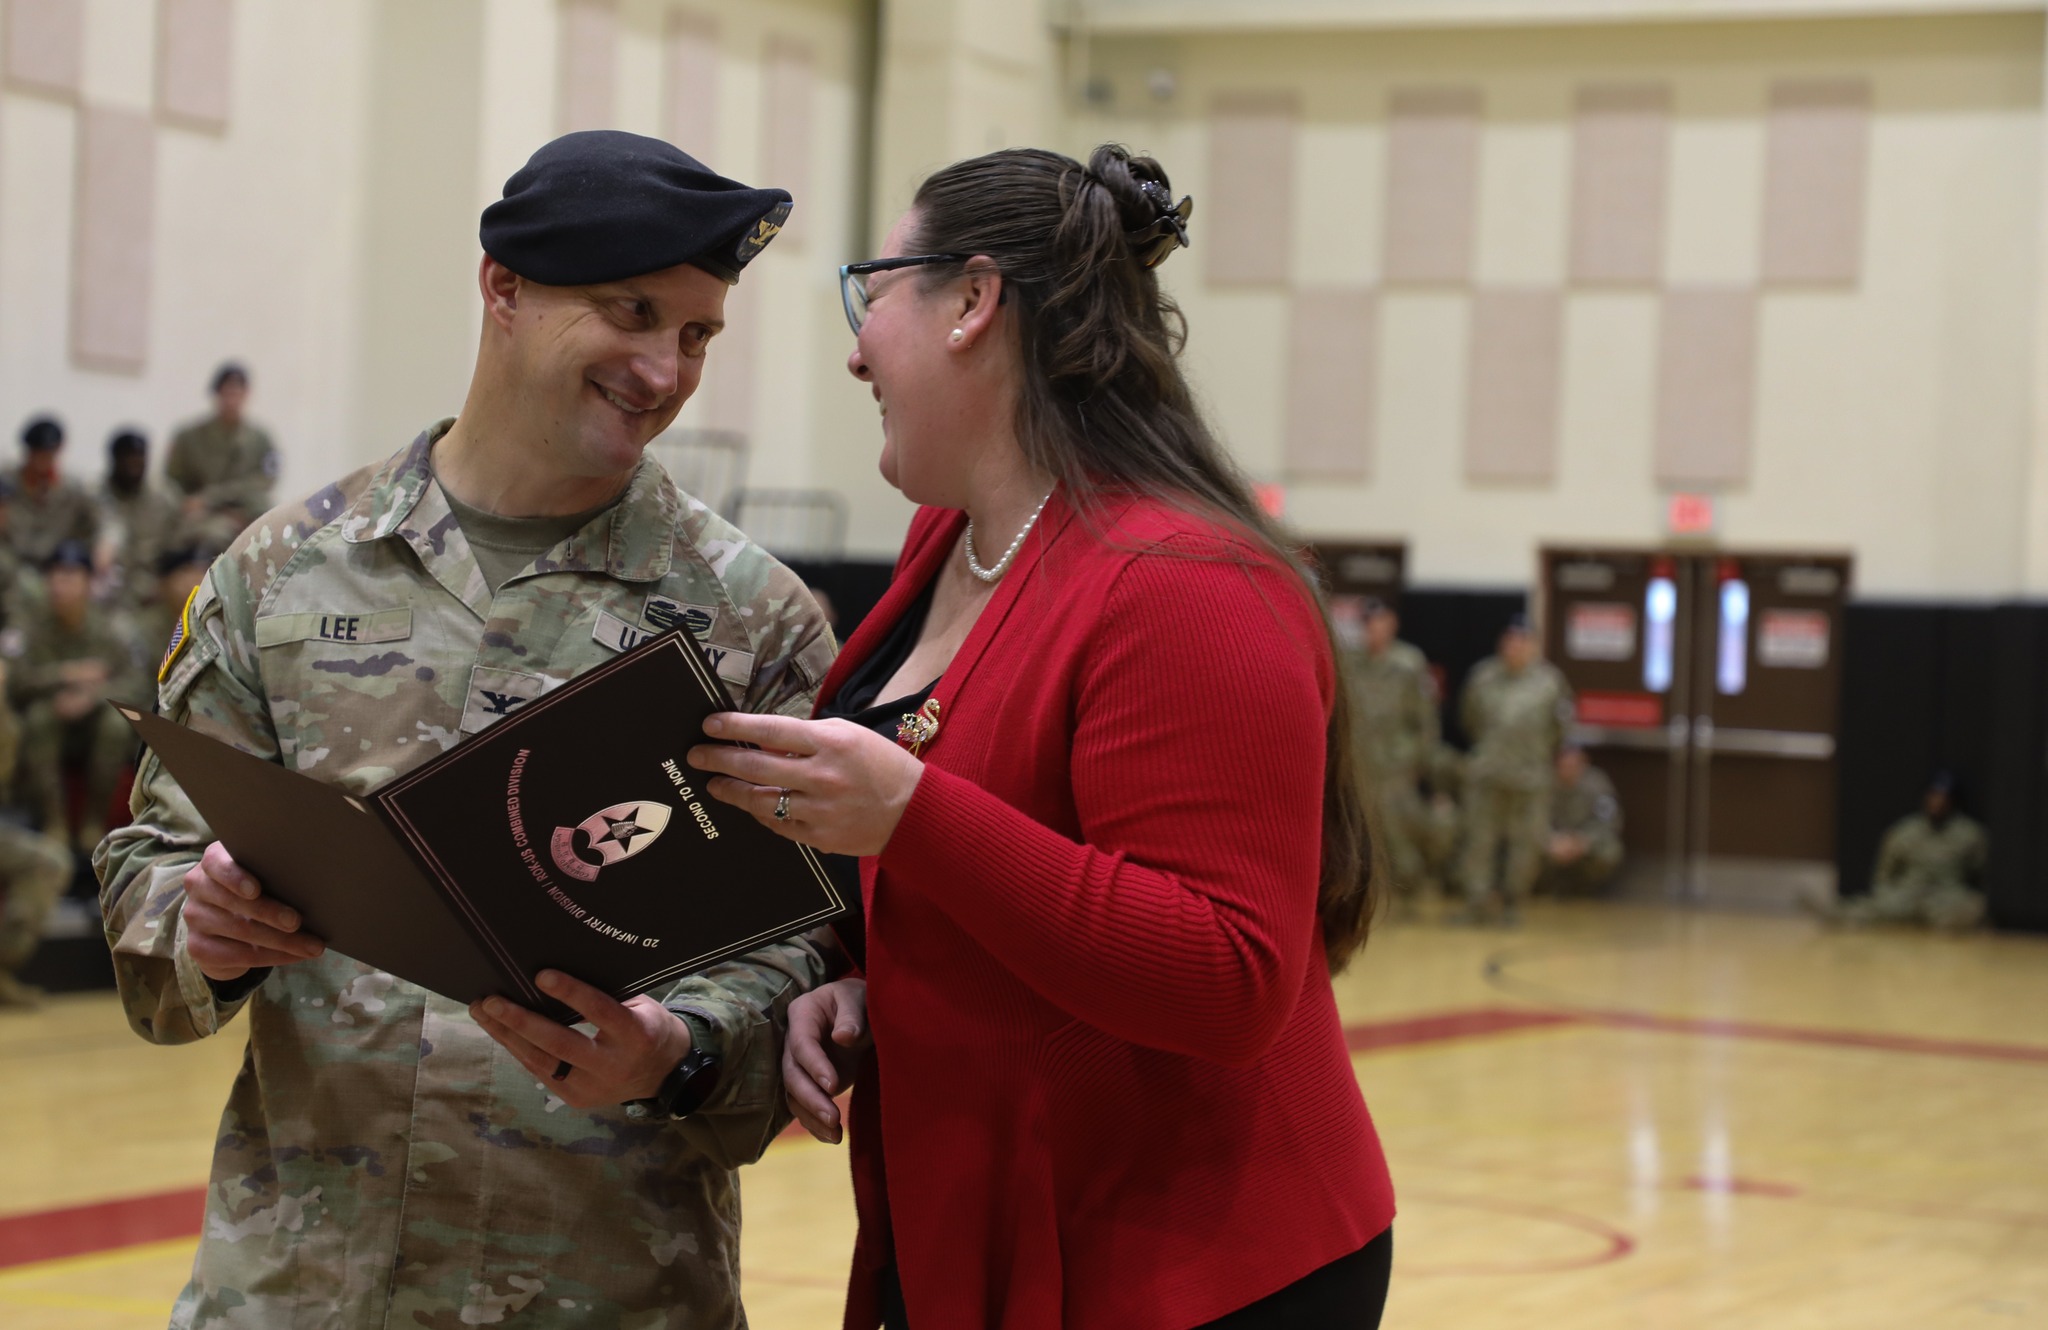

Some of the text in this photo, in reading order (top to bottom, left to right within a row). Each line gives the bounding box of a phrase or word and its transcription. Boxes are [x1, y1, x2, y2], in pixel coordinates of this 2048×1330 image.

[319, 616, 360, 641] LEE
[507, 748, 531, 795] DIVISION
[661, 758, 719, 840] SECOND TO NONE
[507, 796, 529, 847] COMBINED
[520, 848, 549, 882] ROK-US
[547, 886, 587, 919] DIVISION
[583, 916, 639, 945] INFANTRY
[642, 937, 660, 948] 2D
